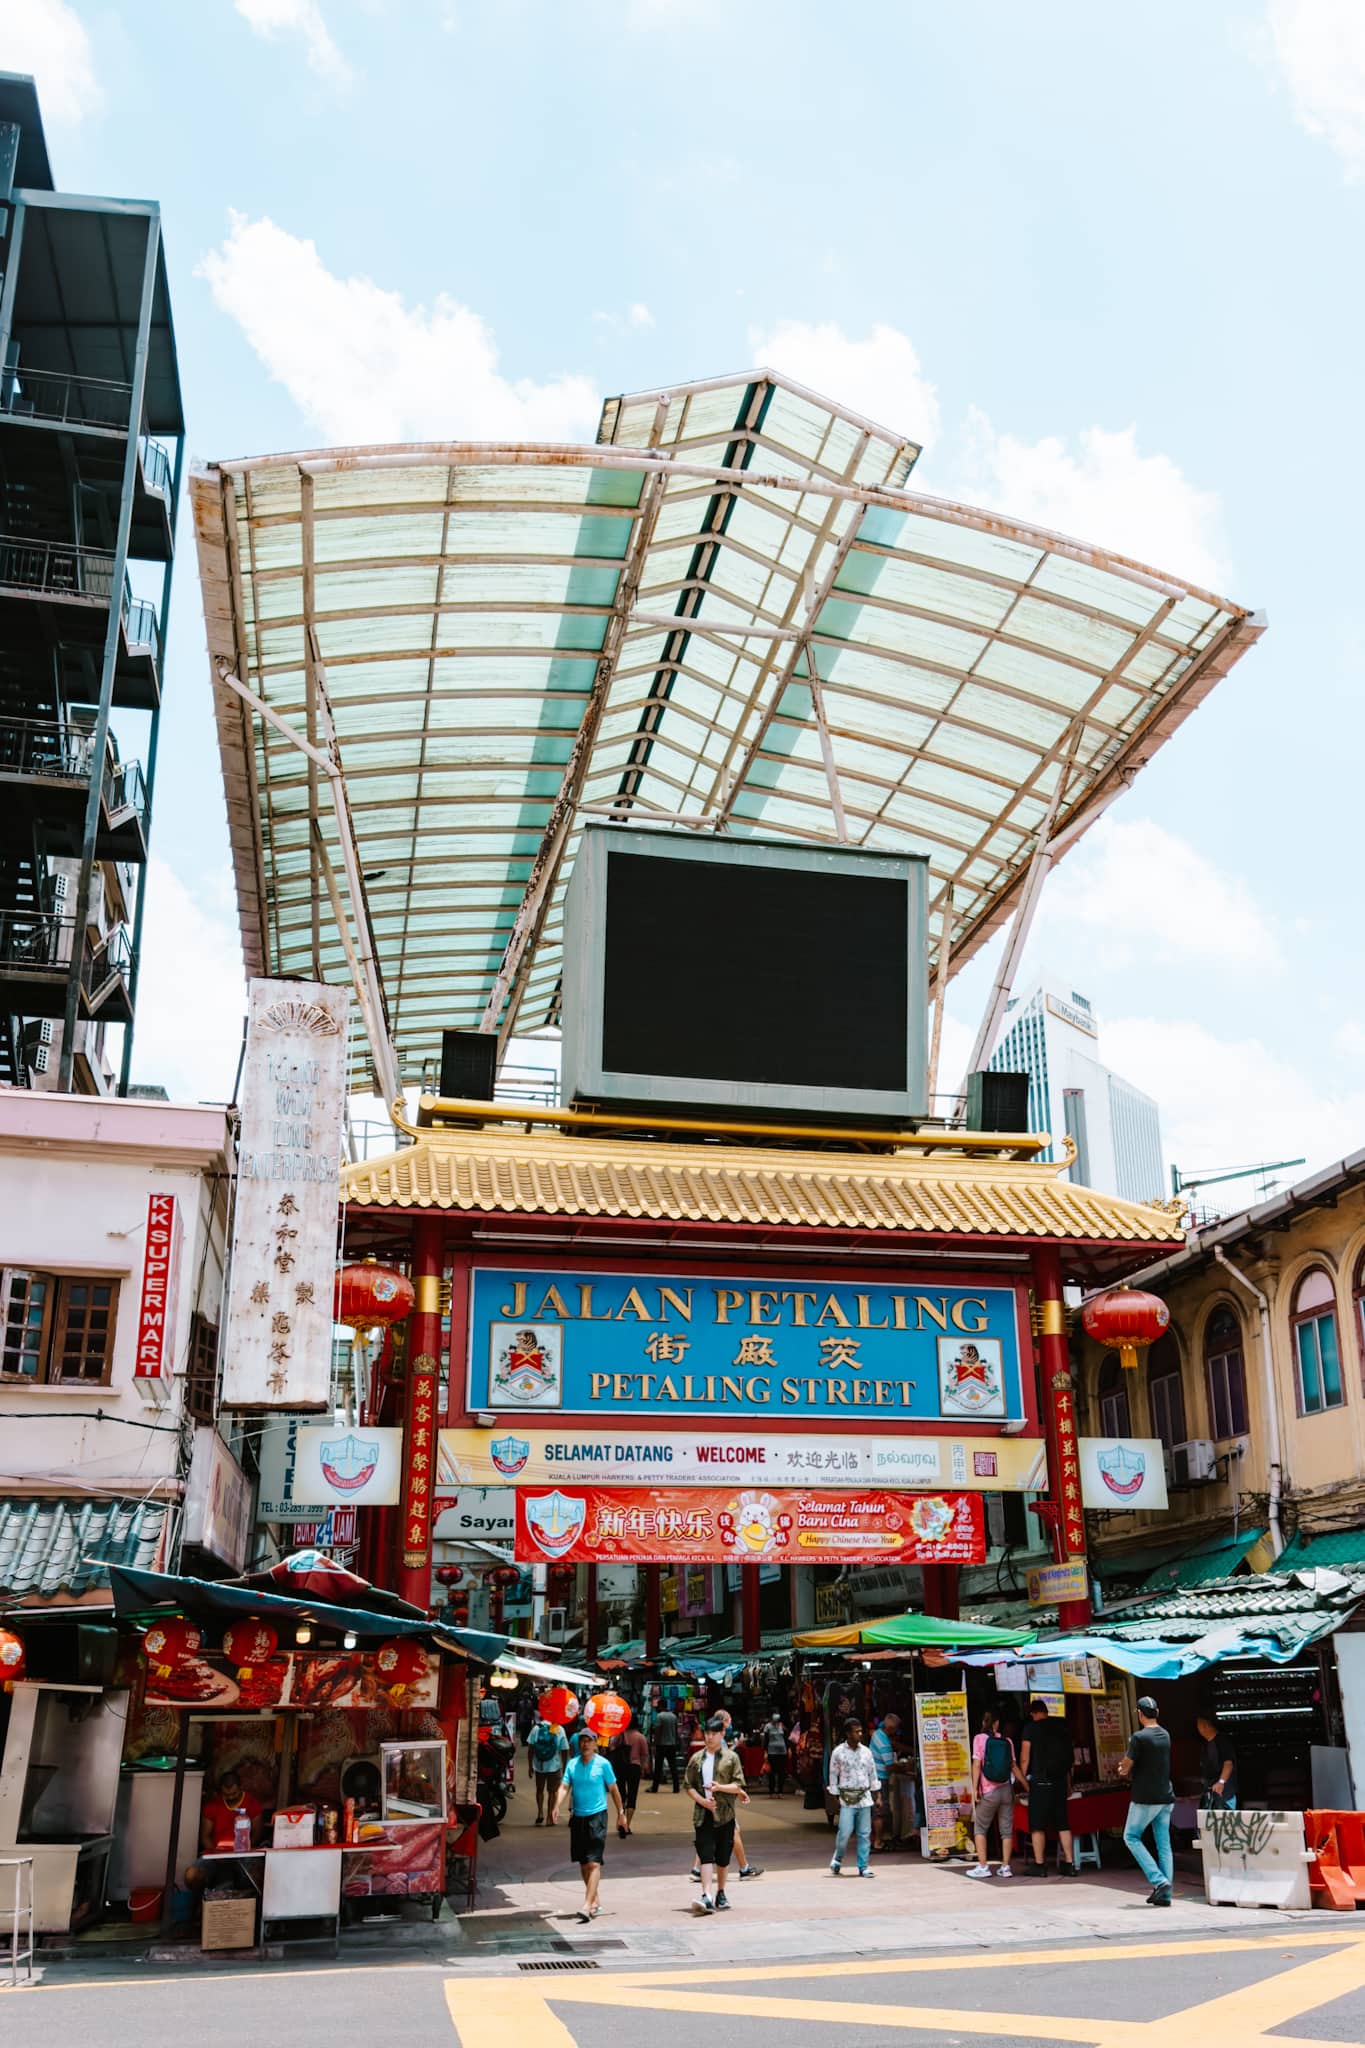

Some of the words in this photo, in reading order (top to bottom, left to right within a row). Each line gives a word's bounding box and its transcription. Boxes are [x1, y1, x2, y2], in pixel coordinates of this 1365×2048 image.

[501, 1282, 695, 1322] JALAN
[712, 1288, 990, 1332] PETALING
[590, 1373, 771, 1404] PETALING
[782, 1376, 916, 1406] STREET
[544, 1444, 610, 1461] SELAMAT
[615, 1445, 673, 1462] DATANG
[696, 1446, 766, 1464] WELCOME
[786, 1450, 859, 1470] 欢迎光临
[261, 1502, 274, 1512] TEL
[798, 1500, 847, 1513] Selamat
[849, 1501, 885, 1513] Tahun
[316, 1512, 333, 1544] 24
[334, 1514, 354, 1541] JAM
[598, 1506, 714, 1540] 新年快乐
[798, 1514, 828, 1527] Baru
[831, 1514, 859, 1527] Cina
[806, 1535, 829, 1544] Happy
[832, 1535, 860, 1544] Chinese
[862, 1535, 878, 1543] New
[881, 1535, 897, 1543] Year
